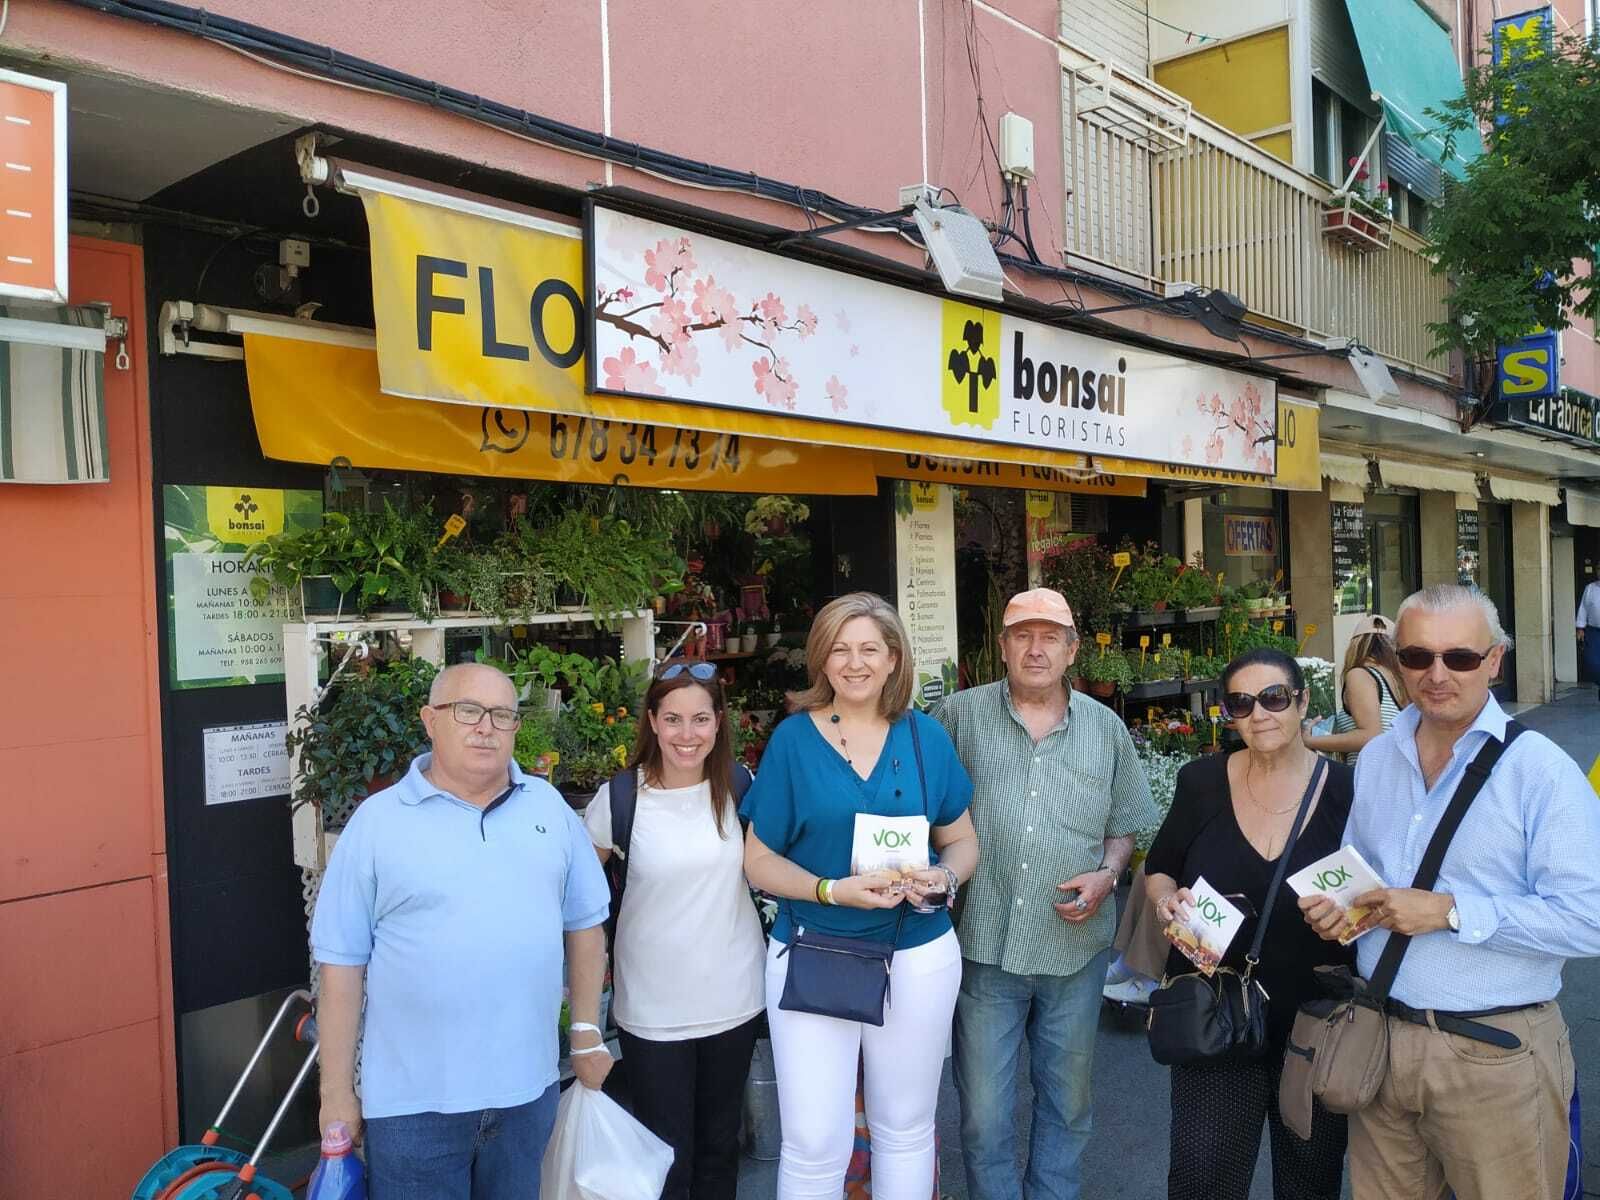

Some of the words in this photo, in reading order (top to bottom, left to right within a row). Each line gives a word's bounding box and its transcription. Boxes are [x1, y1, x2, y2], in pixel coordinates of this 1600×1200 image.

[1013, 330, 1127, 417] bonsai
[1012, 410, 1126, 447] FLORISTAS
[228, 517, 265, 530] bonsai
[1226, 519, 1274, 552] OFERTAS
[207, 586, 239, 597] LUNES
[241, 585, 248, 596] A
[232, 609, 259, 619] 18:00
[227, 631, 275, 643] SÁBADOS
[239, 644, 266, 654] 10:00
[231, 731, 276, 743] MAÑANAS
[238, 766, 271, 777] TARDES
[872, 828, 912, 848] VOX
[1312, 864, 1354, 892] VOX
[1195, 894, 1228, 929] VOX
